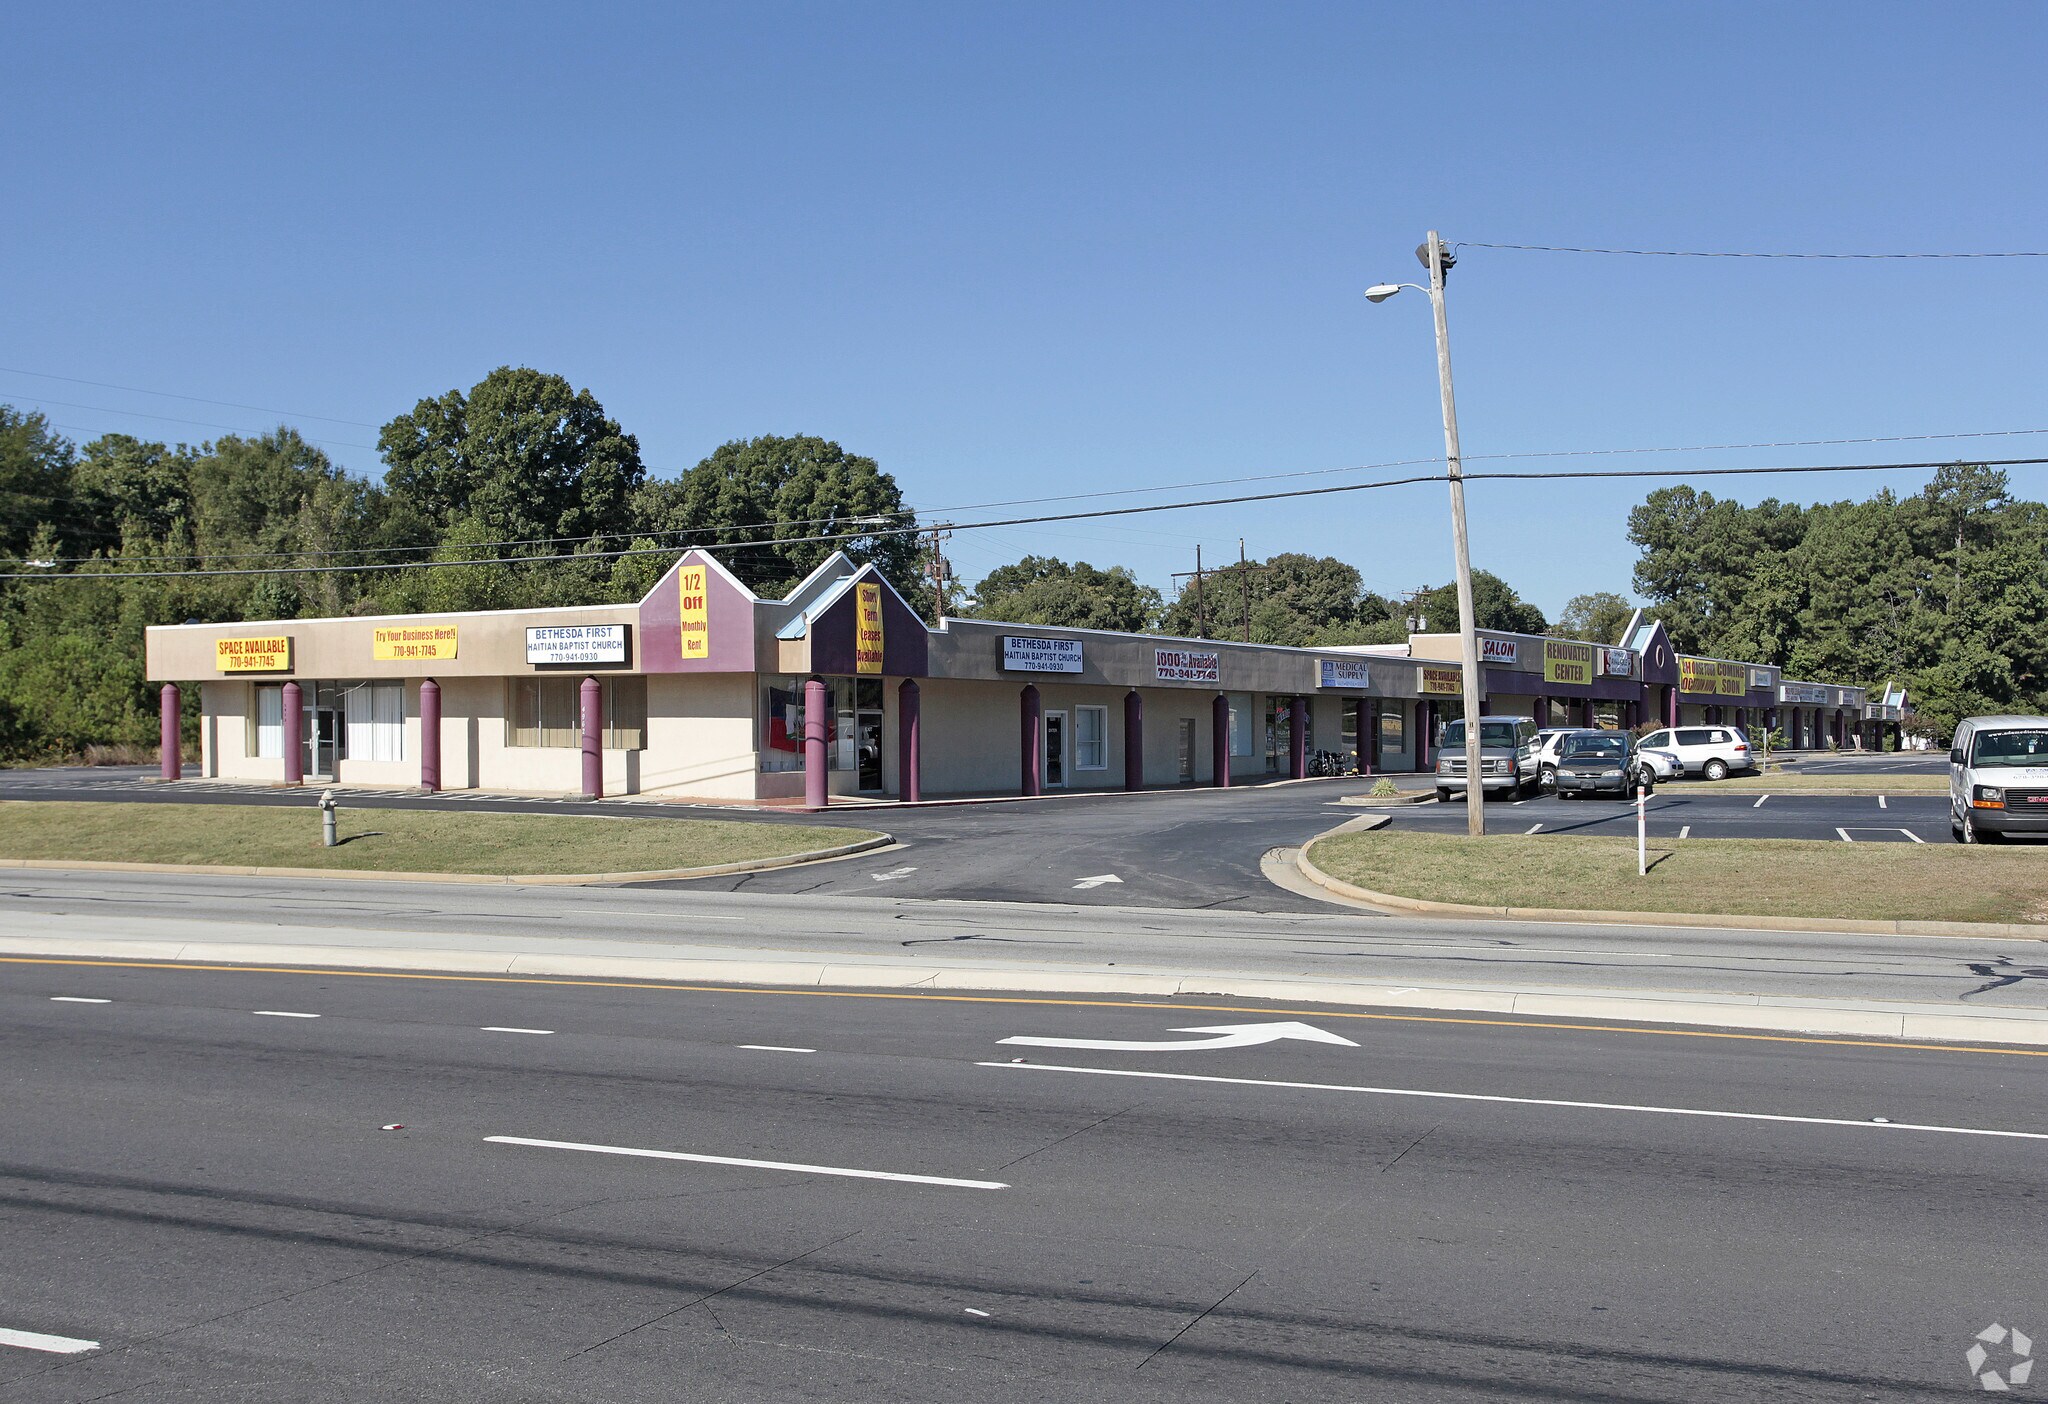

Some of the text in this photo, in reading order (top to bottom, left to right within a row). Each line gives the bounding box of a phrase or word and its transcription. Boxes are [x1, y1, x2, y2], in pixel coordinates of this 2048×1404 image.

[684, 573, 701, 591] 1/2
[683, 595, 703, 610] Off
[863, 608, 878, 621] Term
[682, 620, 707, 632] Monthly
[375, 630, 386, 642] Try
[387, 630, 402, 641] Your
[402, 629, 433, 641] Business
[535, 627, 613, 639] BETHESDA FIRST
[860, 627, 881, 641] Leases
[219, 639, 285, 655] SPACE AVAILABLE
[393, 645, 437, 656] 770-941-7745
[527, 640, 623, 651] HAITIAN BAPTIST CHURCH
[687, 639, 702, 650] Rent
[1011, 638, 1075, 651] BETHESDA FIRST
[1483, 640, 1515, 657] SALON
[550, 652, 598, 661] 770-941-0930
[857, 649, 882, 662] Available
[1004, 651, 1082, 662] HAITIAN BAPTIST CHURCH
[1547, 642, 1590, 662] RENOVATED
[230, 655, 275, 668] 770-941-7745
[1024, 662, 1064, 671] 770-941-0930
[1156, 652, 1181, 666] 1000
[1188, 654, 1217, 669] Available
[1335, 662, 1367, 671] MEDICAL
[1158, 668, 1217, 679] 770-941-7745
[1338, 671, 1364, 679] SUPPLY
[1423, 670, 1461, 682] SPACE AVAILABLE
[1554, 663, 1584, 681] CENTER
[1717, 663, 1745, 678] COMING
[1721, 678, 1740, 694] SOON
